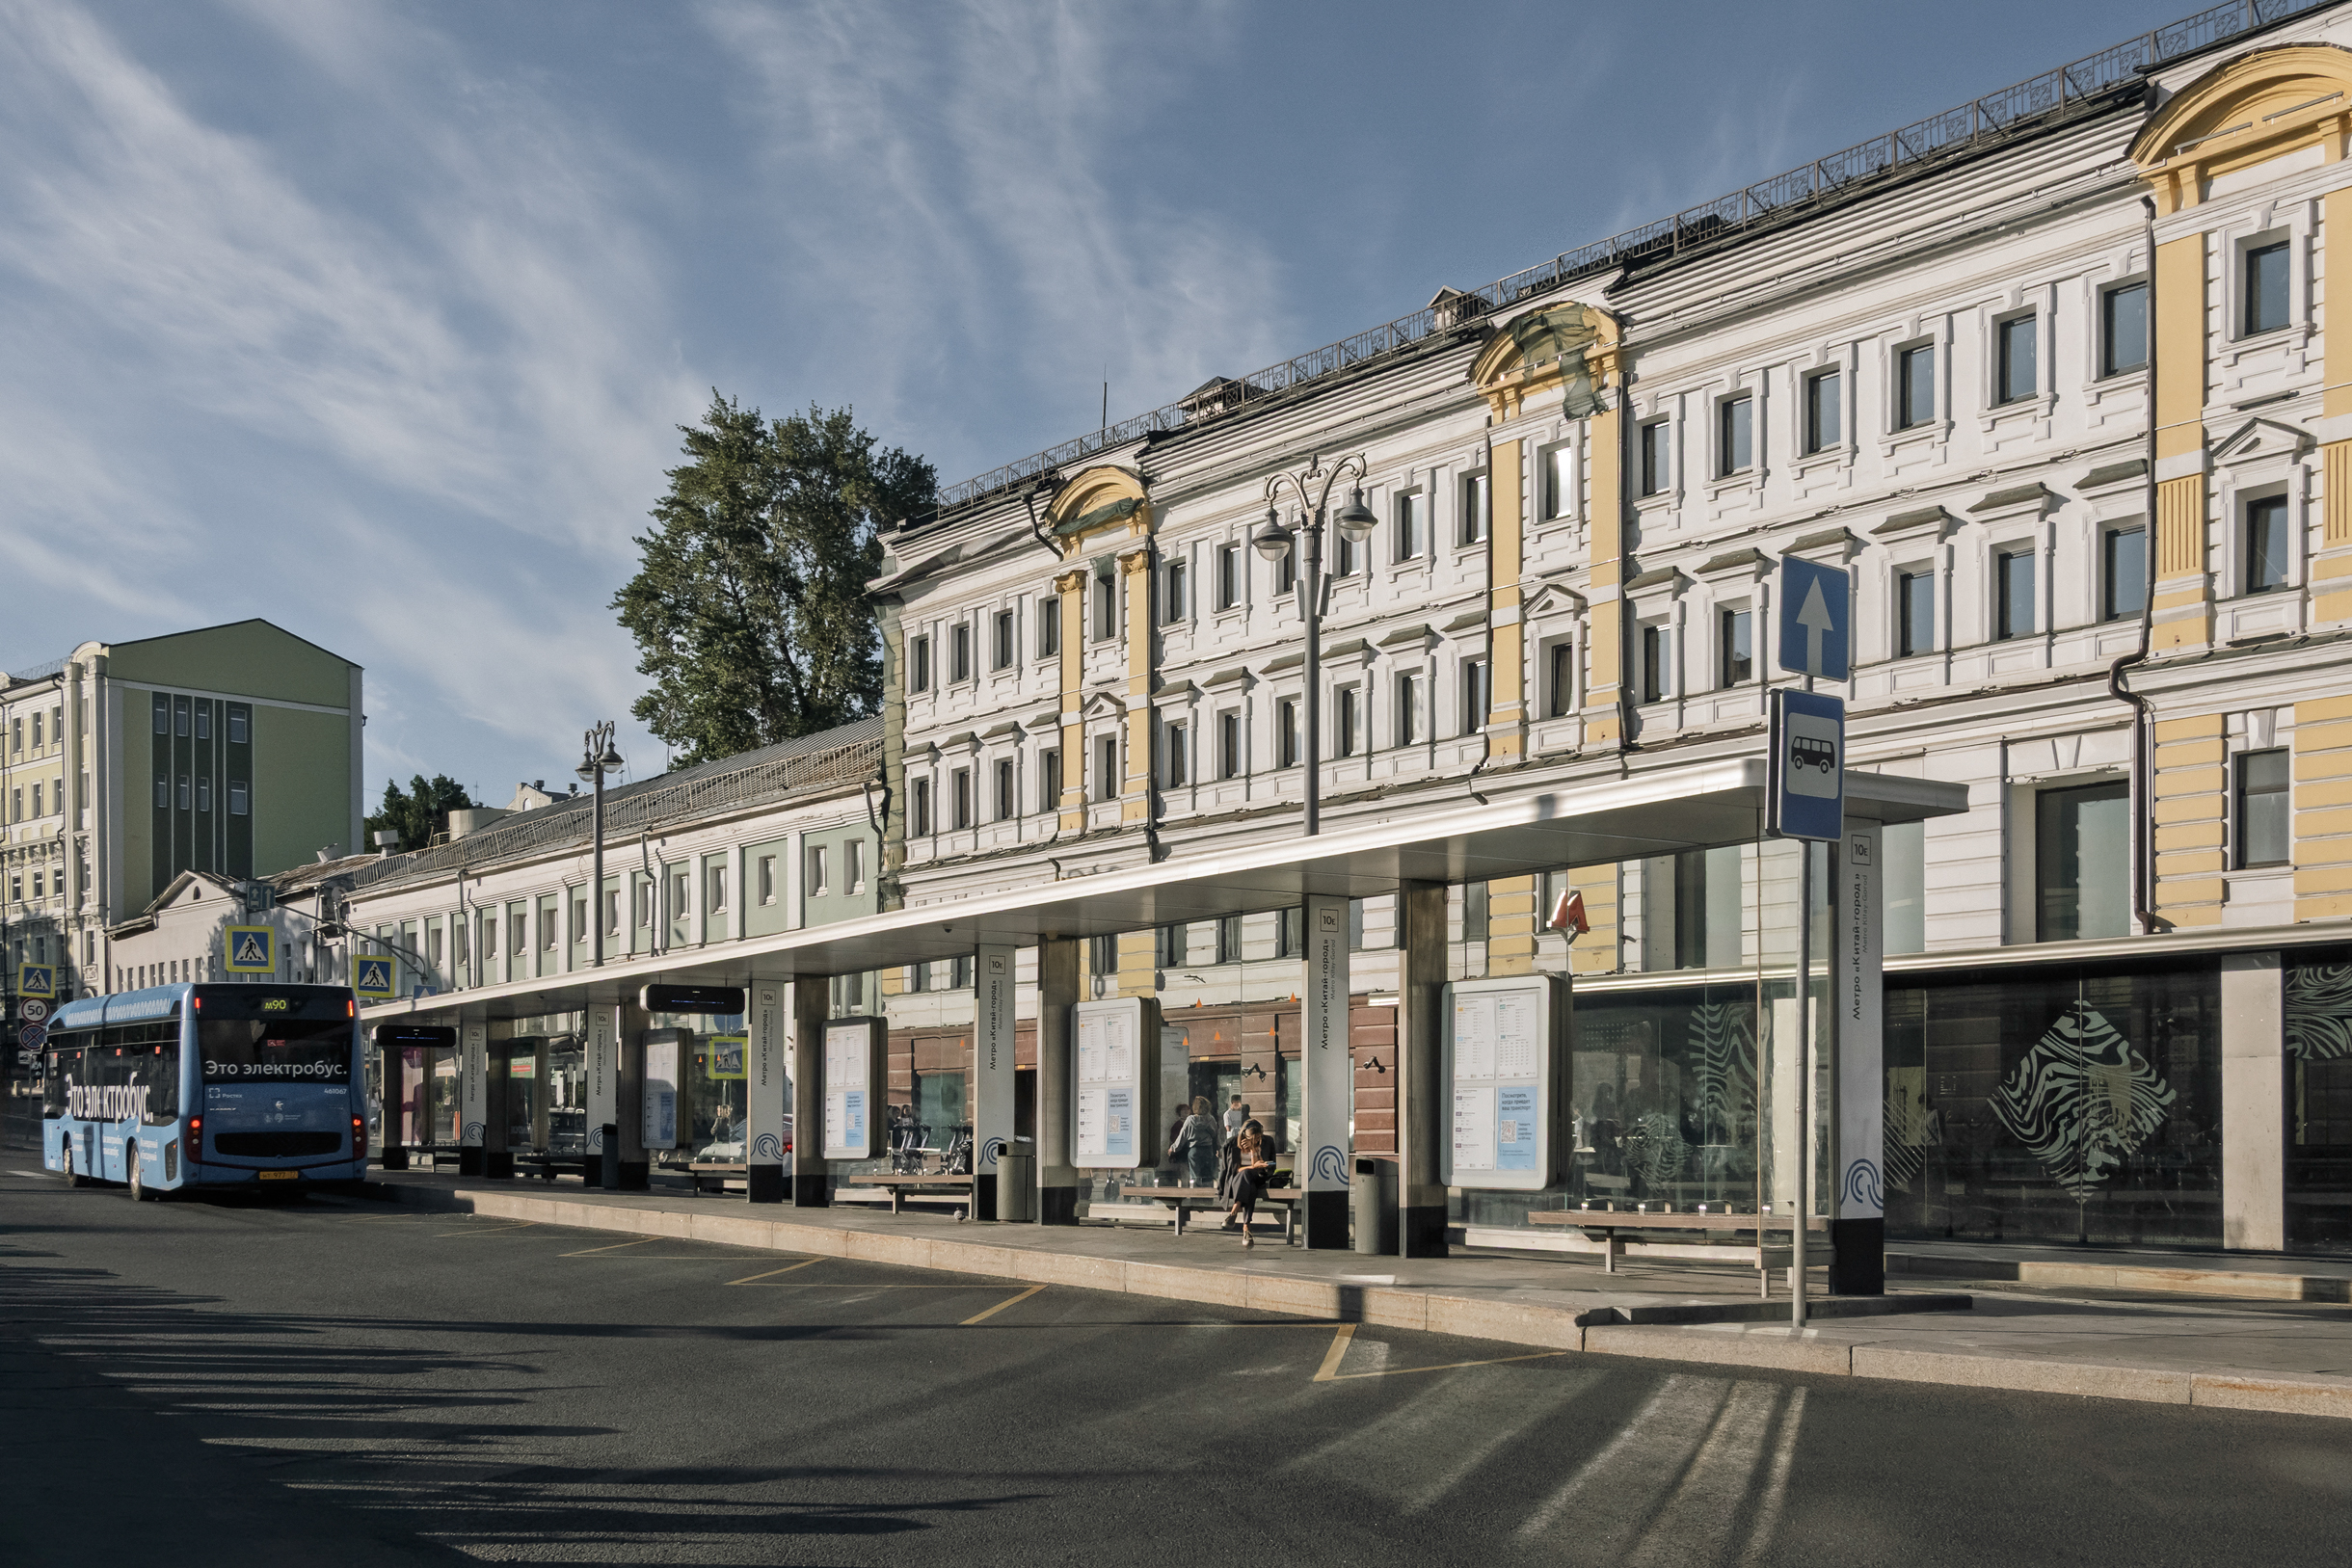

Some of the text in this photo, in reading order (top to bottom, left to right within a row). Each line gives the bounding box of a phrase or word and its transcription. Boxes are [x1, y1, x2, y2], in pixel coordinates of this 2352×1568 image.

[1854, 843, 1868, 857] 10Е
[1323, 916, 1336, 925] 10Е
[1852, 873, 1862, 1021] Метро «Китай-город»
[1321, 939, 1329, 1014] «Китай-город»
[28, 1005, 43, 1016] 50
[205, 1060, 347, 1078] Это электробус.
[65, 1071, 154, 1133] Это электробус.
